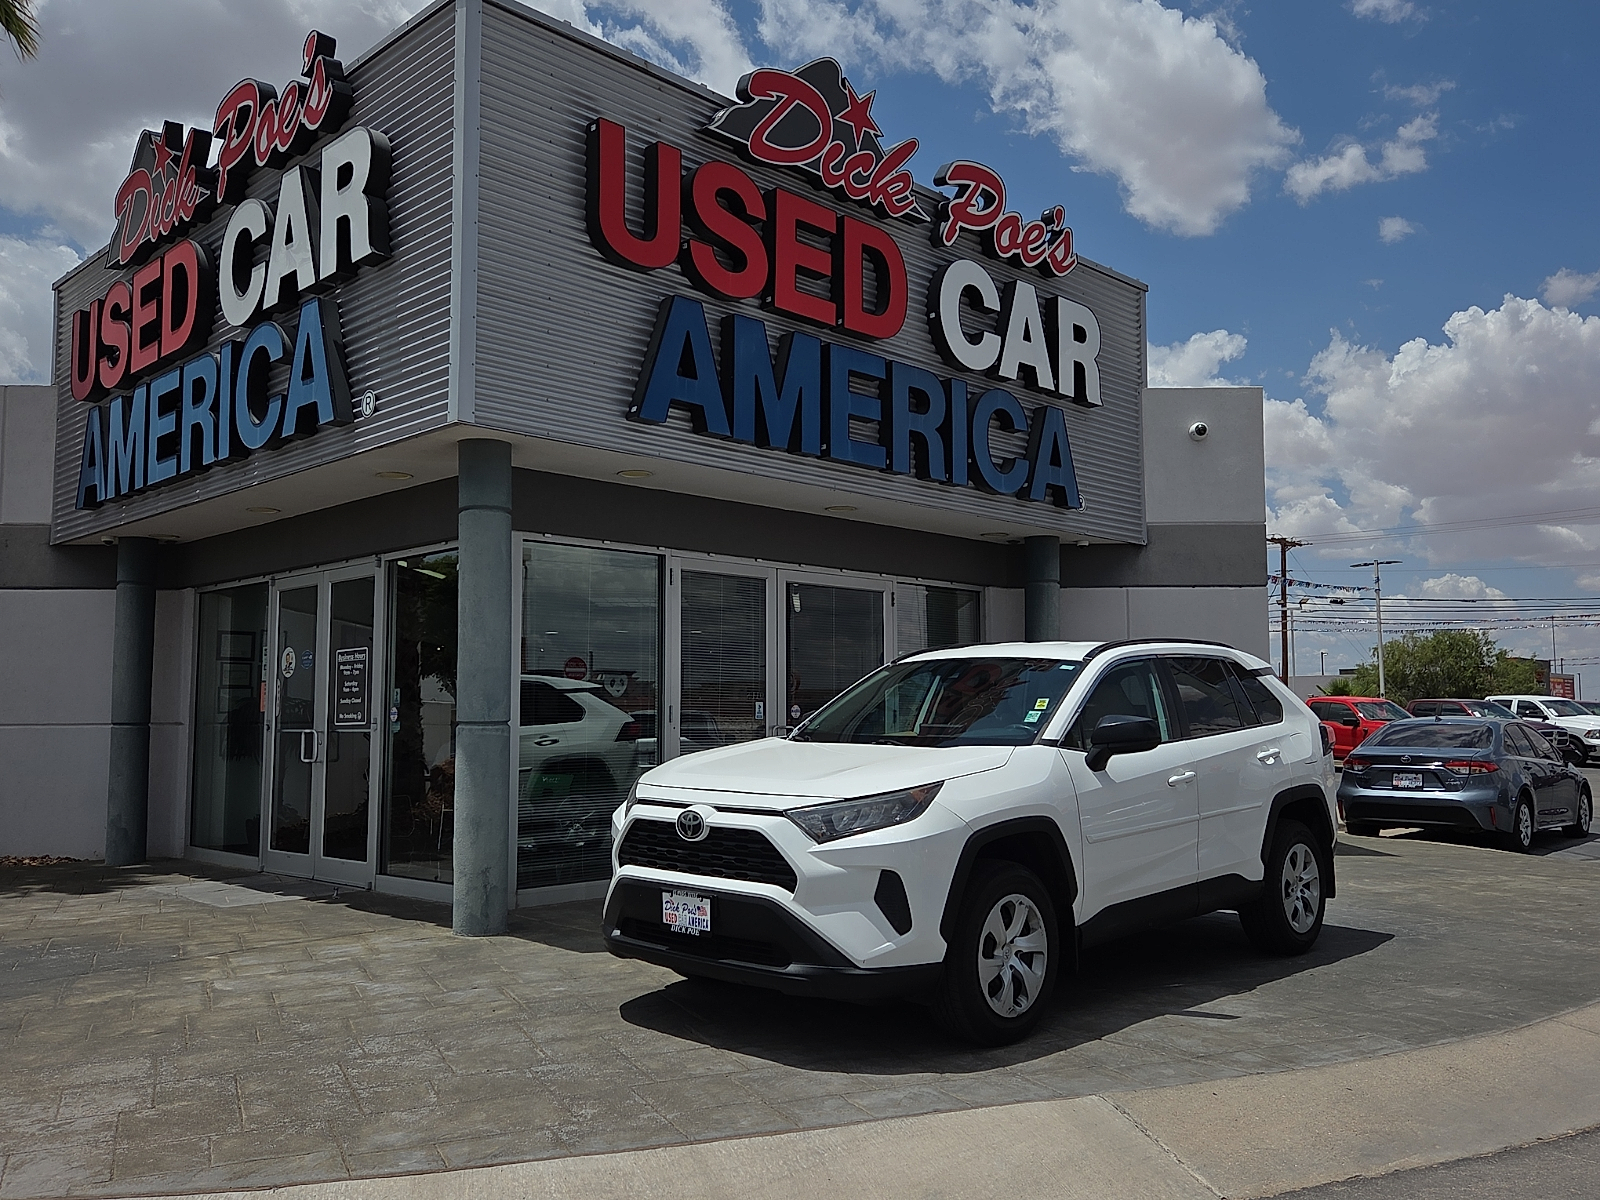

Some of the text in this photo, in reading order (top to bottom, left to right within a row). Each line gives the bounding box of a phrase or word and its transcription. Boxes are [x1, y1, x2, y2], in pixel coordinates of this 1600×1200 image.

[115, 29, 334, 268] Dick Poe's
[598, 117, 1103, 406] USED CAR
[746, 67, 1079, 278] Dick Poe's
[70, 126, 374, 402] USED CAR
[75, 297, 336, 511] AMERICA
[638, 295, 1081, 509] AMERICA
